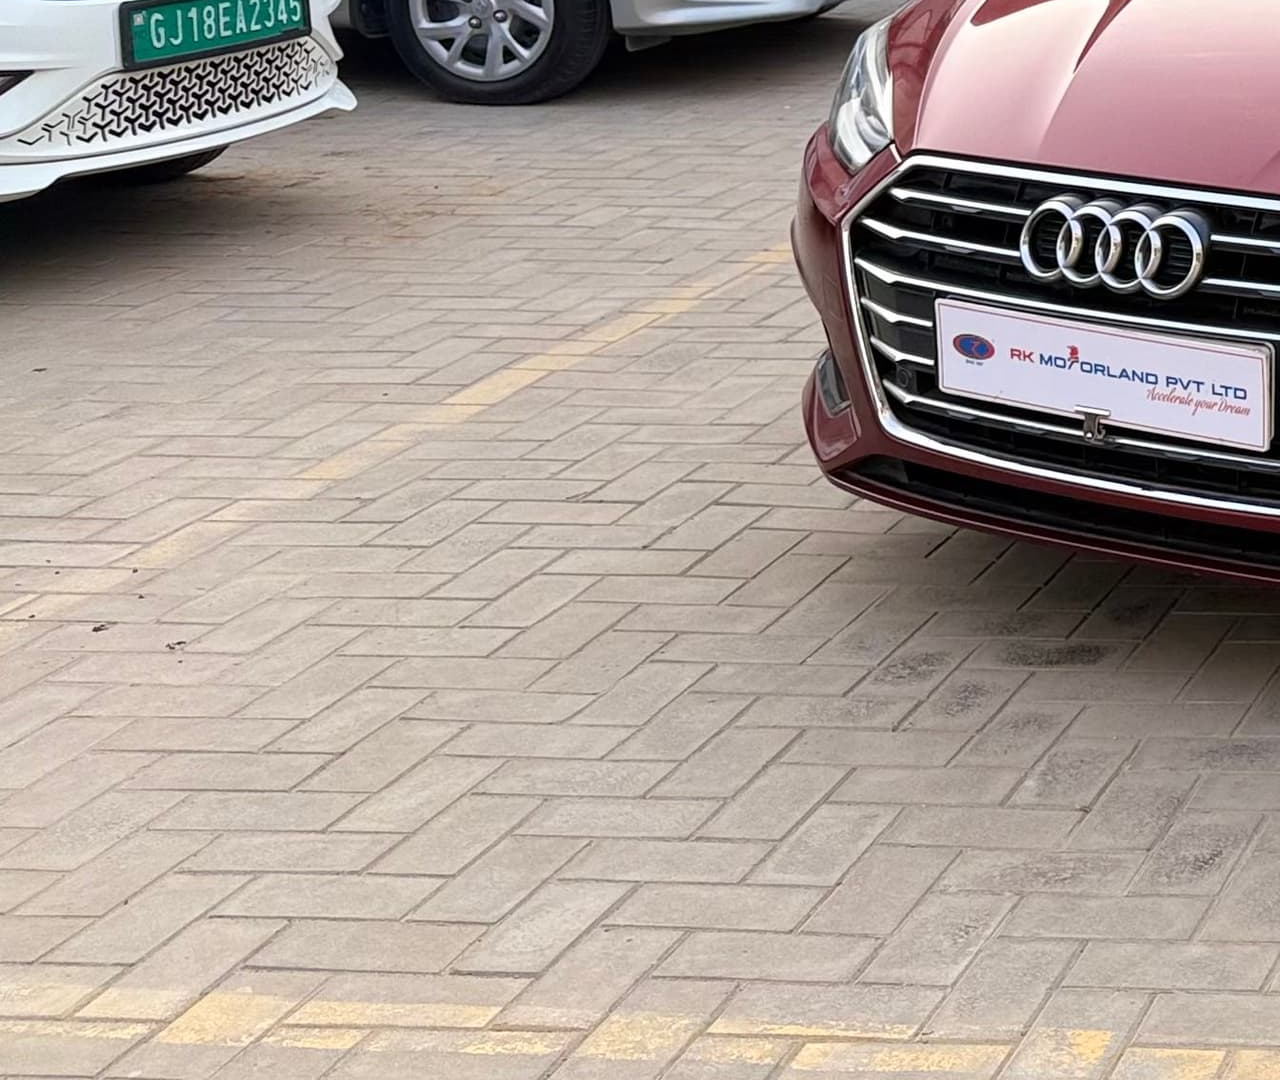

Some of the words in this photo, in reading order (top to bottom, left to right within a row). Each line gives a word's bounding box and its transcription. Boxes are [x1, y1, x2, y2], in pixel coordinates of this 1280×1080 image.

[1010, 348, 1034, 363] RK
[1166, 376, 1204, 392] PVT
[1212, 384, 1247, 400] LTD
[1146, 386, 1193, 406] Accelerate
[1192, 400, 1217, 416] your
[1218, 400, 1250, 416] Dream
